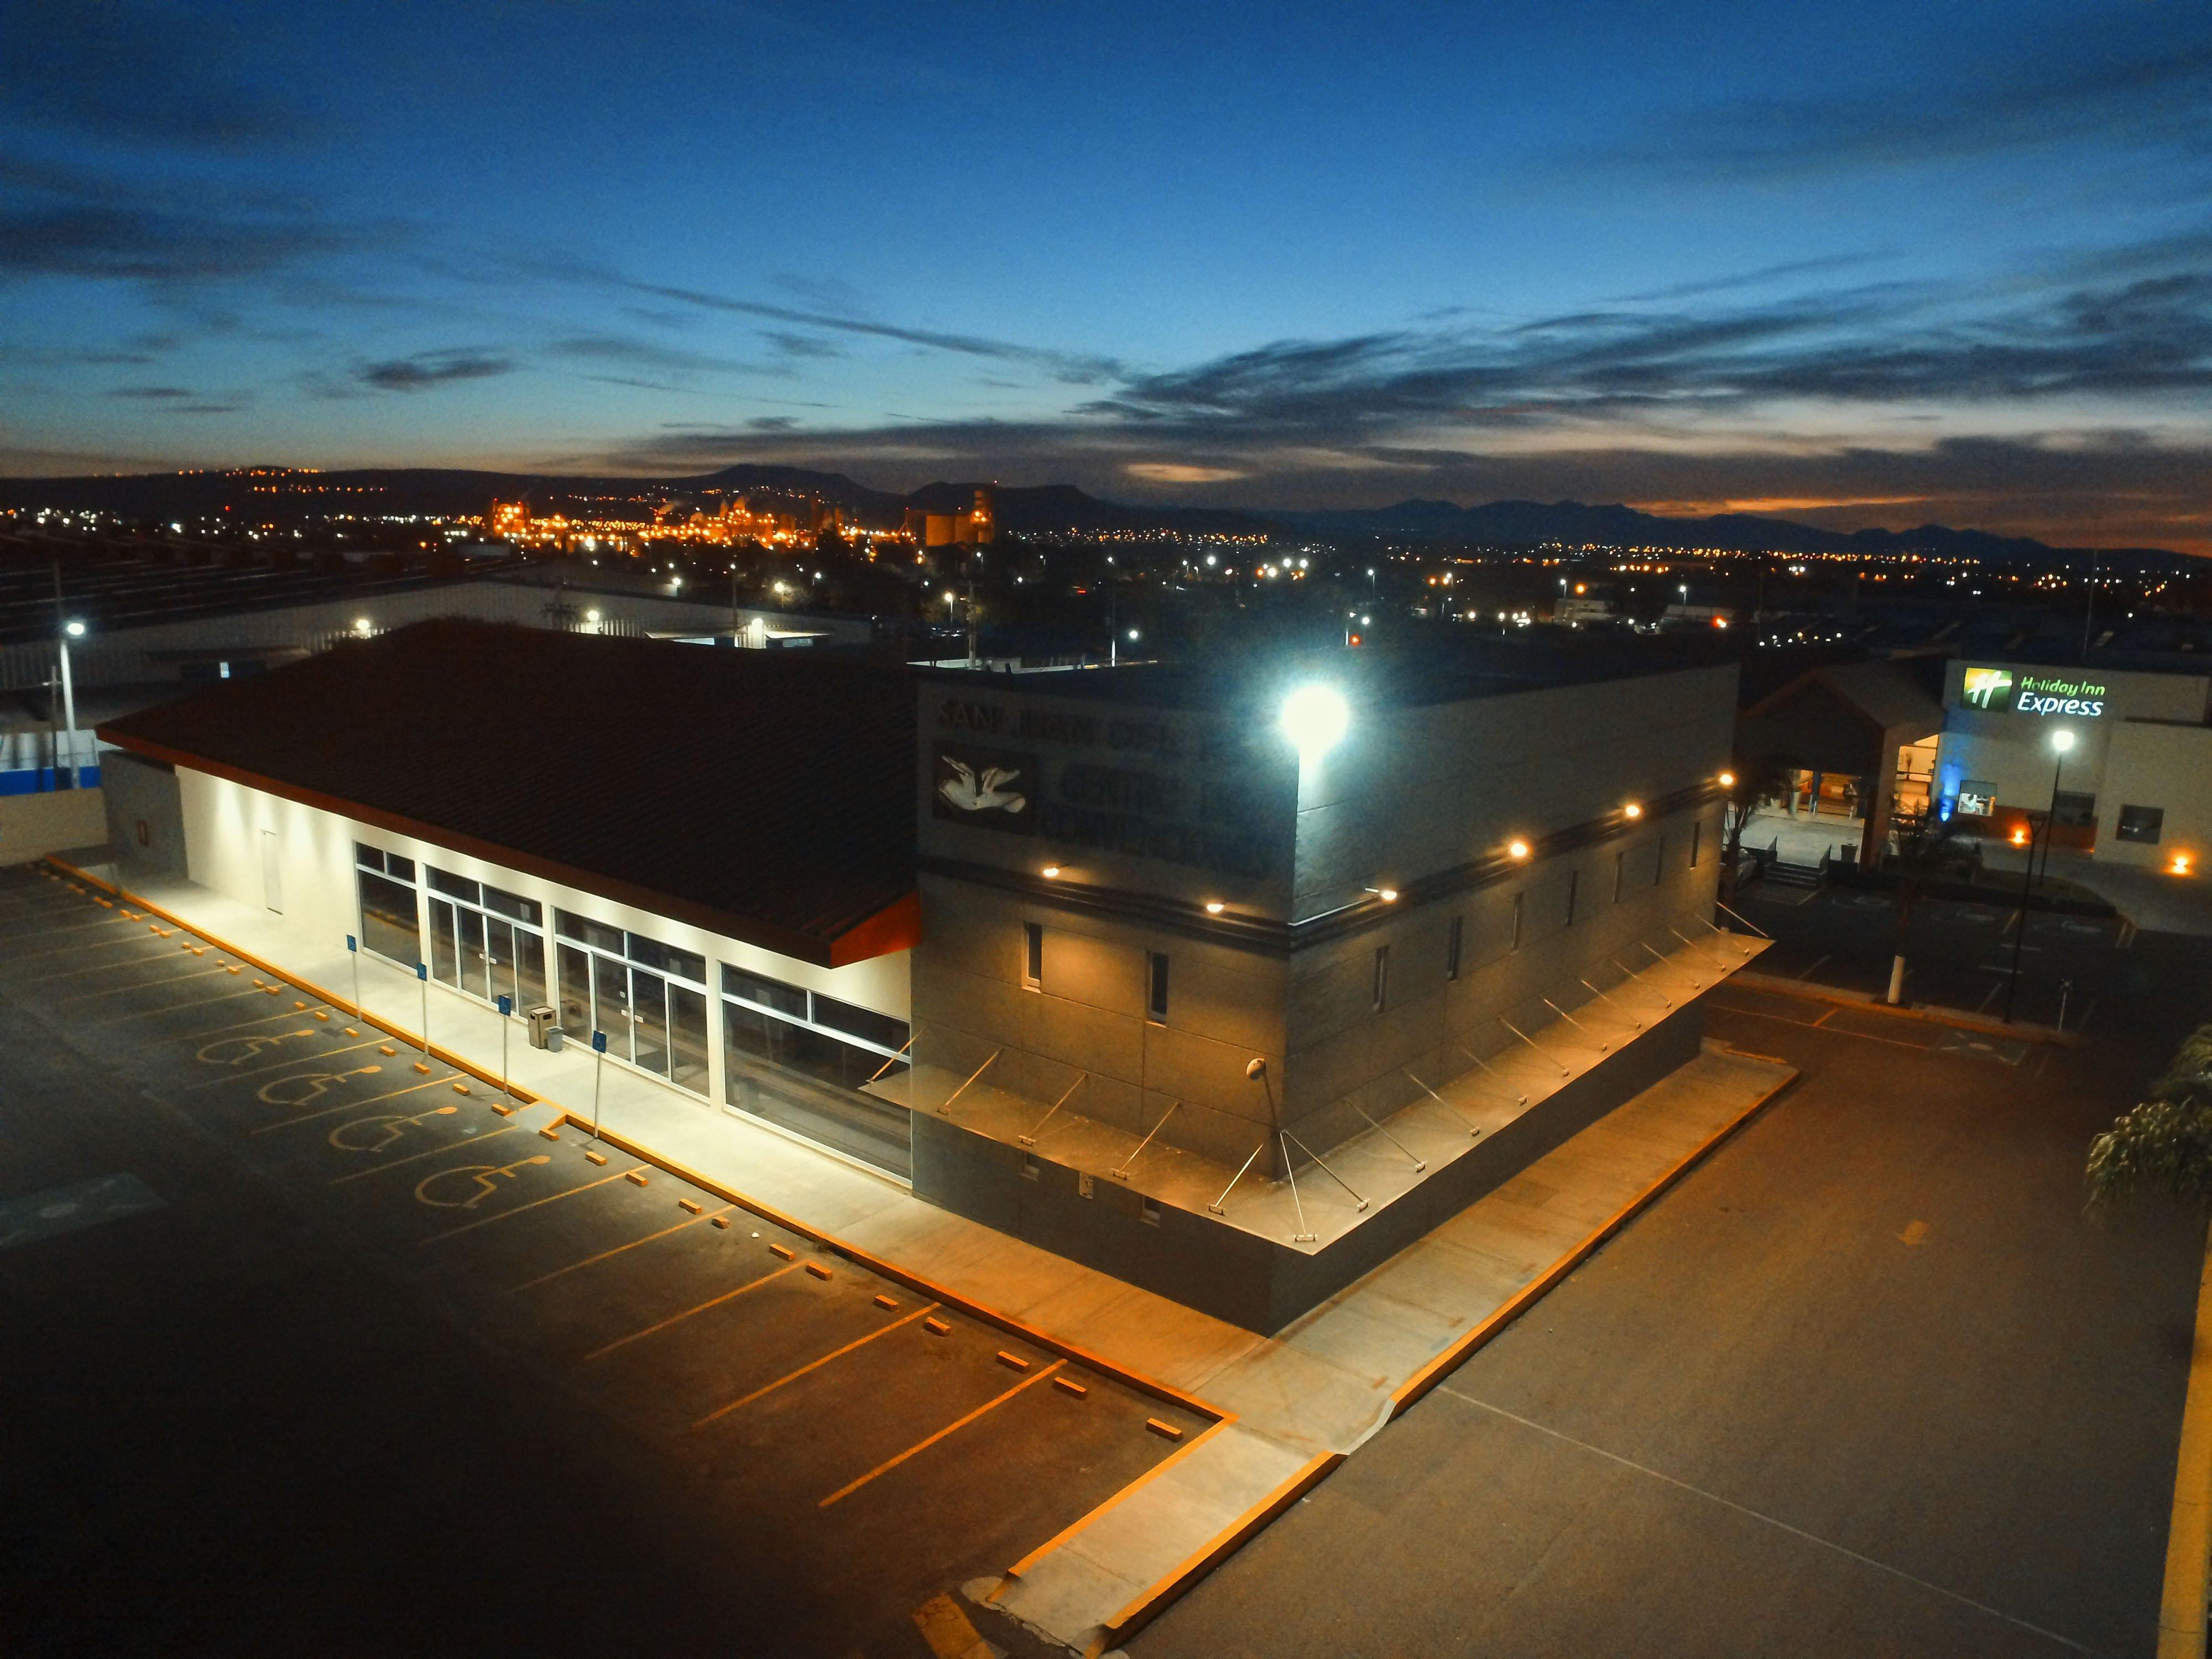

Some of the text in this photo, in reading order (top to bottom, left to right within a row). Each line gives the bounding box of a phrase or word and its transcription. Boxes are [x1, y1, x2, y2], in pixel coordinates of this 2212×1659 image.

[2021, 676, 2105, 697] Holiday Inn
[2017, 691, 2104, 717] Express
